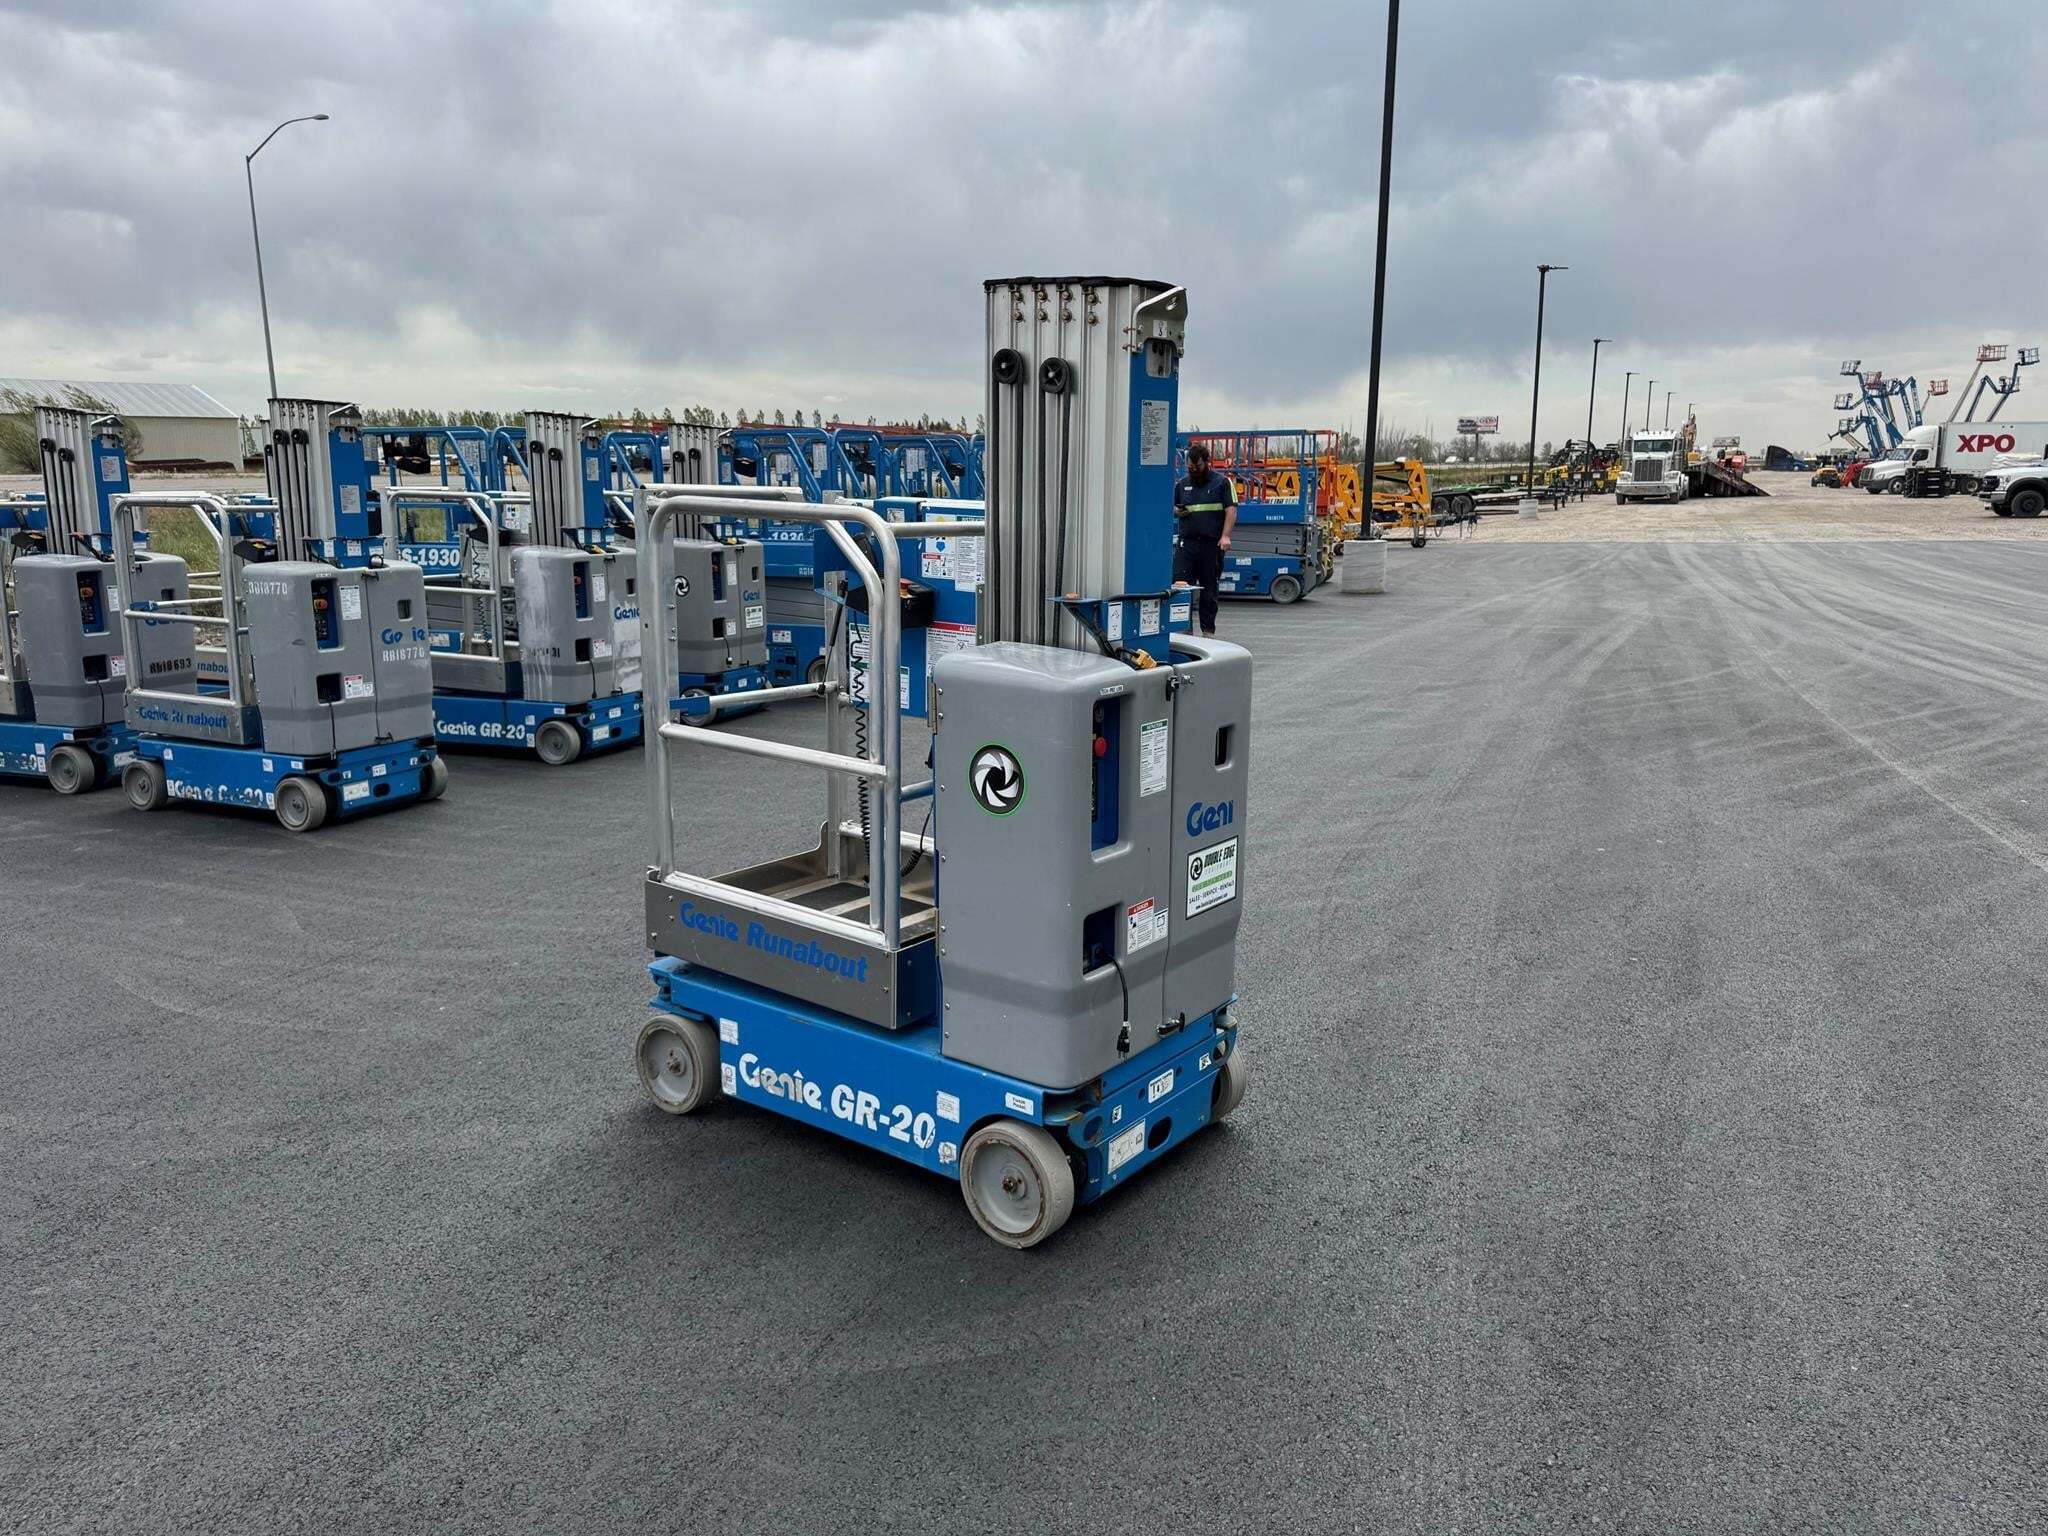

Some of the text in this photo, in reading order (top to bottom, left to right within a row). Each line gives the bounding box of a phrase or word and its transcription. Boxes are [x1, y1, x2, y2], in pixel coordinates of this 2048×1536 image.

[1956, 434, 2016, 453] XPO
[436, 719, 526, 740] Genie GR-20
[680, 902, 869, 983] Genie Runabout
[739, 1052, 822, 1111] Genie
[830, 1083, 937, 1150] GR-20
